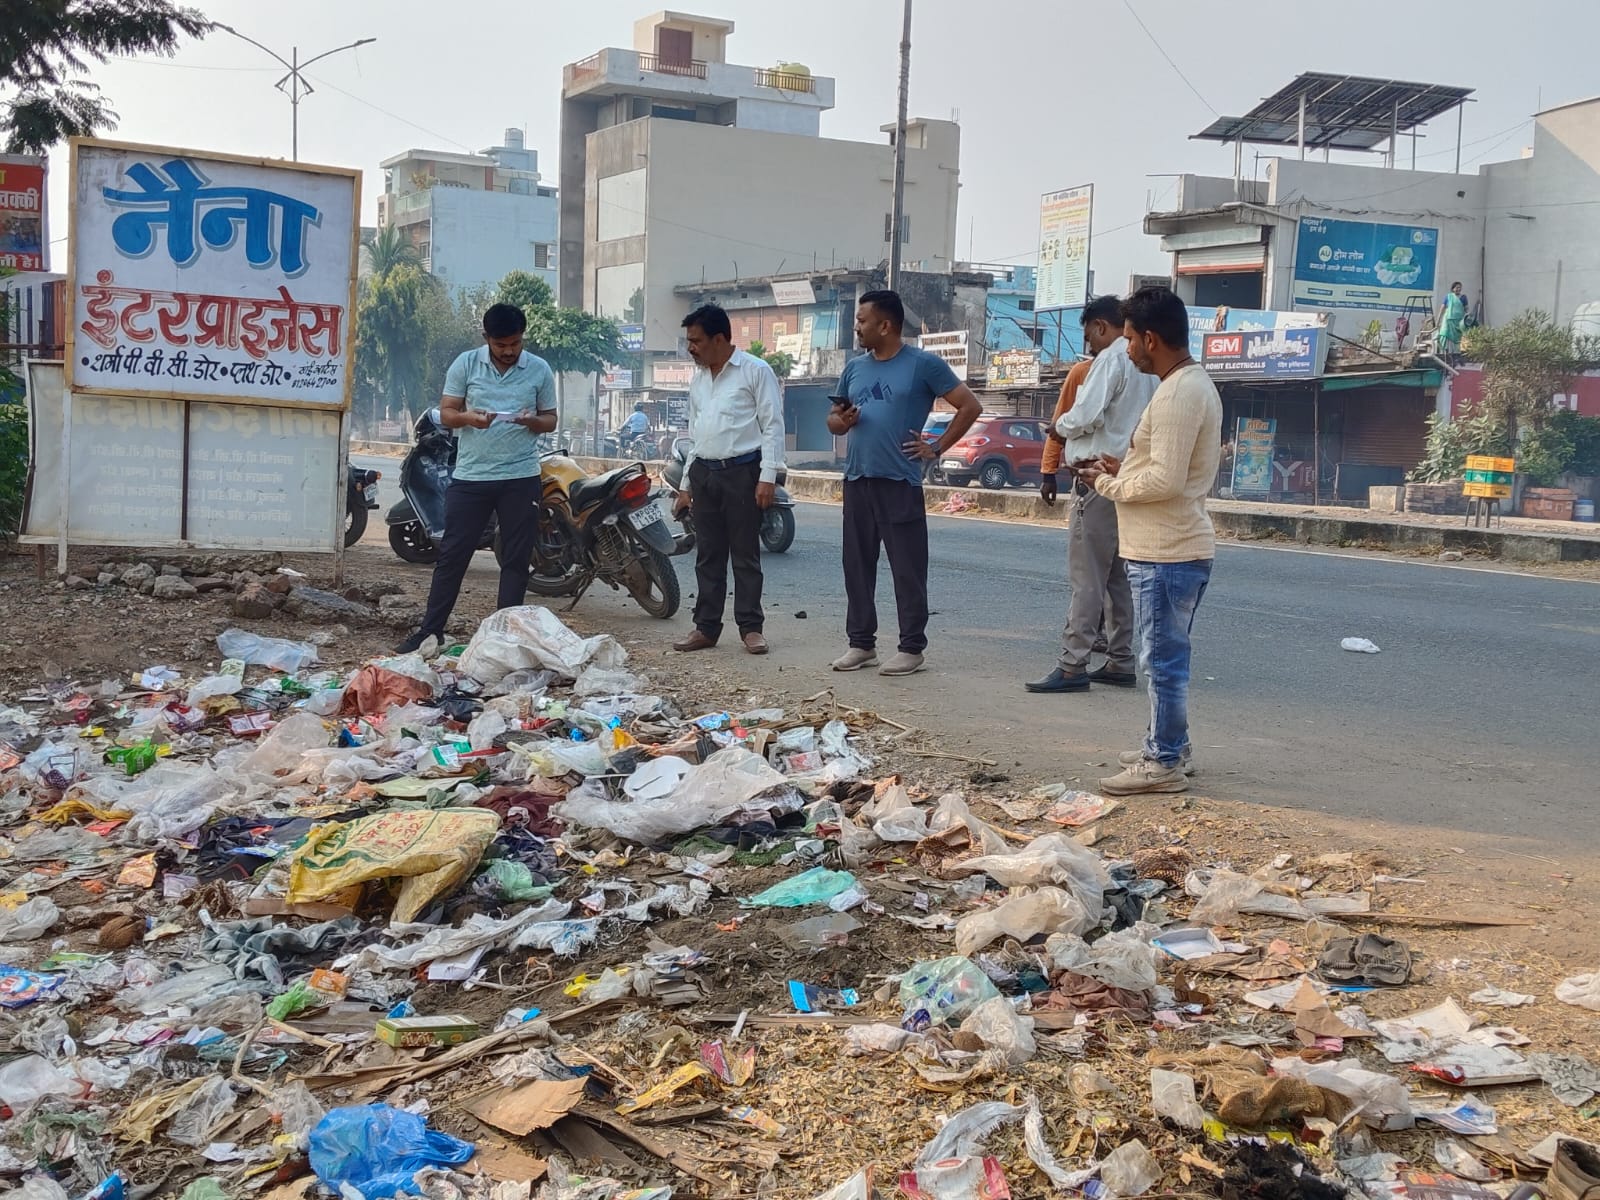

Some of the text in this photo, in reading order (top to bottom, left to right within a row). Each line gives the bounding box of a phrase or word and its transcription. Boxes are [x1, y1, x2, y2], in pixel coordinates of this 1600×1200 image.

[102, 159, 320, 276] नैना
[1333, 248, 1347, 260] होम
[81, 270, 344, 359] इंटरप्राइजेस
[1189, 318, 1216, 330] OTHAR
[1210, 338, 1240, 353] GM
[90, 345, 126, 374] शर्मा
[193, 354, 221, 381] डोर
[260, 360, 284, 386] डोर
[1205, 361, 1266, 370] ROHIT ELECTRICALS
